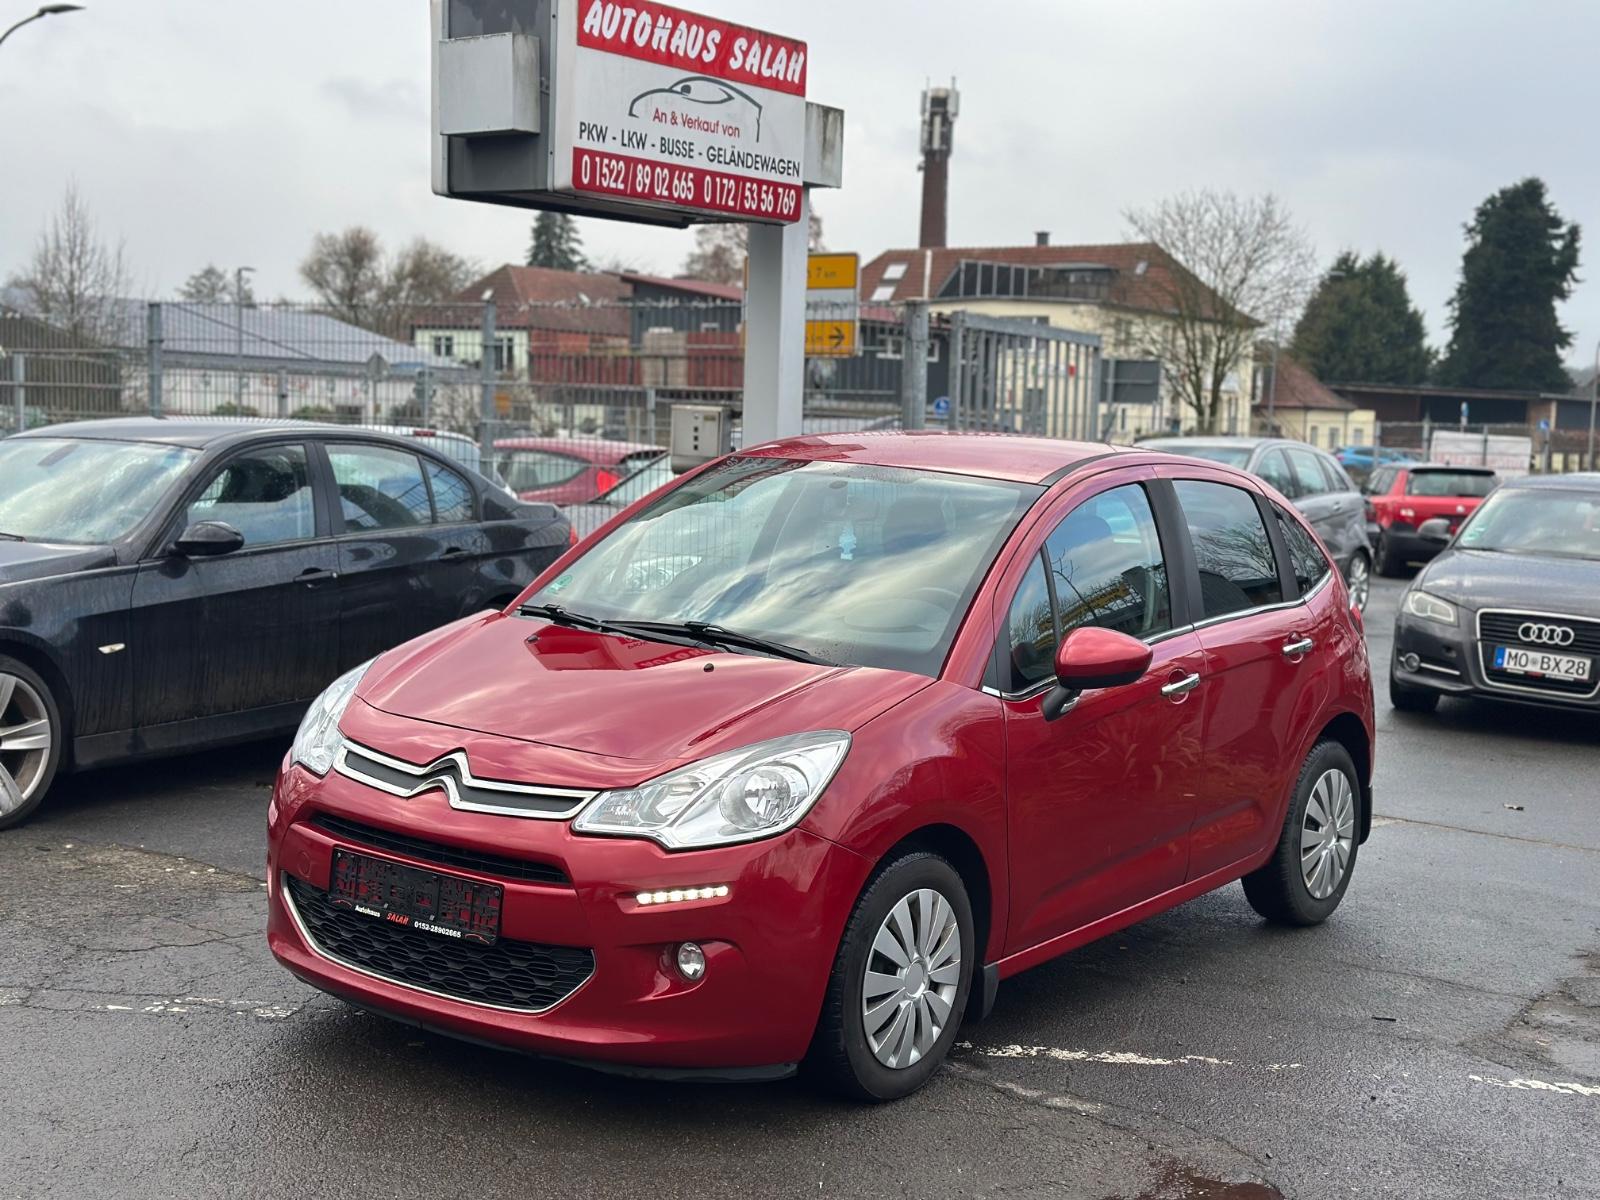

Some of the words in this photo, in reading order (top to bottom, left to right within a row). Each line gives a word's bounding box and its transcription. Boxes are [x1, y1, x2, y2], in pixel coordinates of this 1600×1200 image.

[583, 0, 721, 63] AUTOHAUS
[729, 37, 805, 84] SALAH
[652, 107, 667, 124] An
[670, 111, 678, 126] &
[681, 113, 720, 135] Verkauf
[722, 124, 741, 138] von
[579, 121, 608, 144] PKW
[621, 129, 648, 151] LKW
[660, 136, 695, 159] BUSSE
[706, 145, 800, 177] GELÄNDEWAGEN
[655, 167, 670, 197] 02
[672, 170, 694, 201] 665
[760, 184, 774, 213] 56
[776, 187, 796, 215] 769
[355, 904, 381, 918] Autohaus
[386, 912, 409, 925] SALAH
